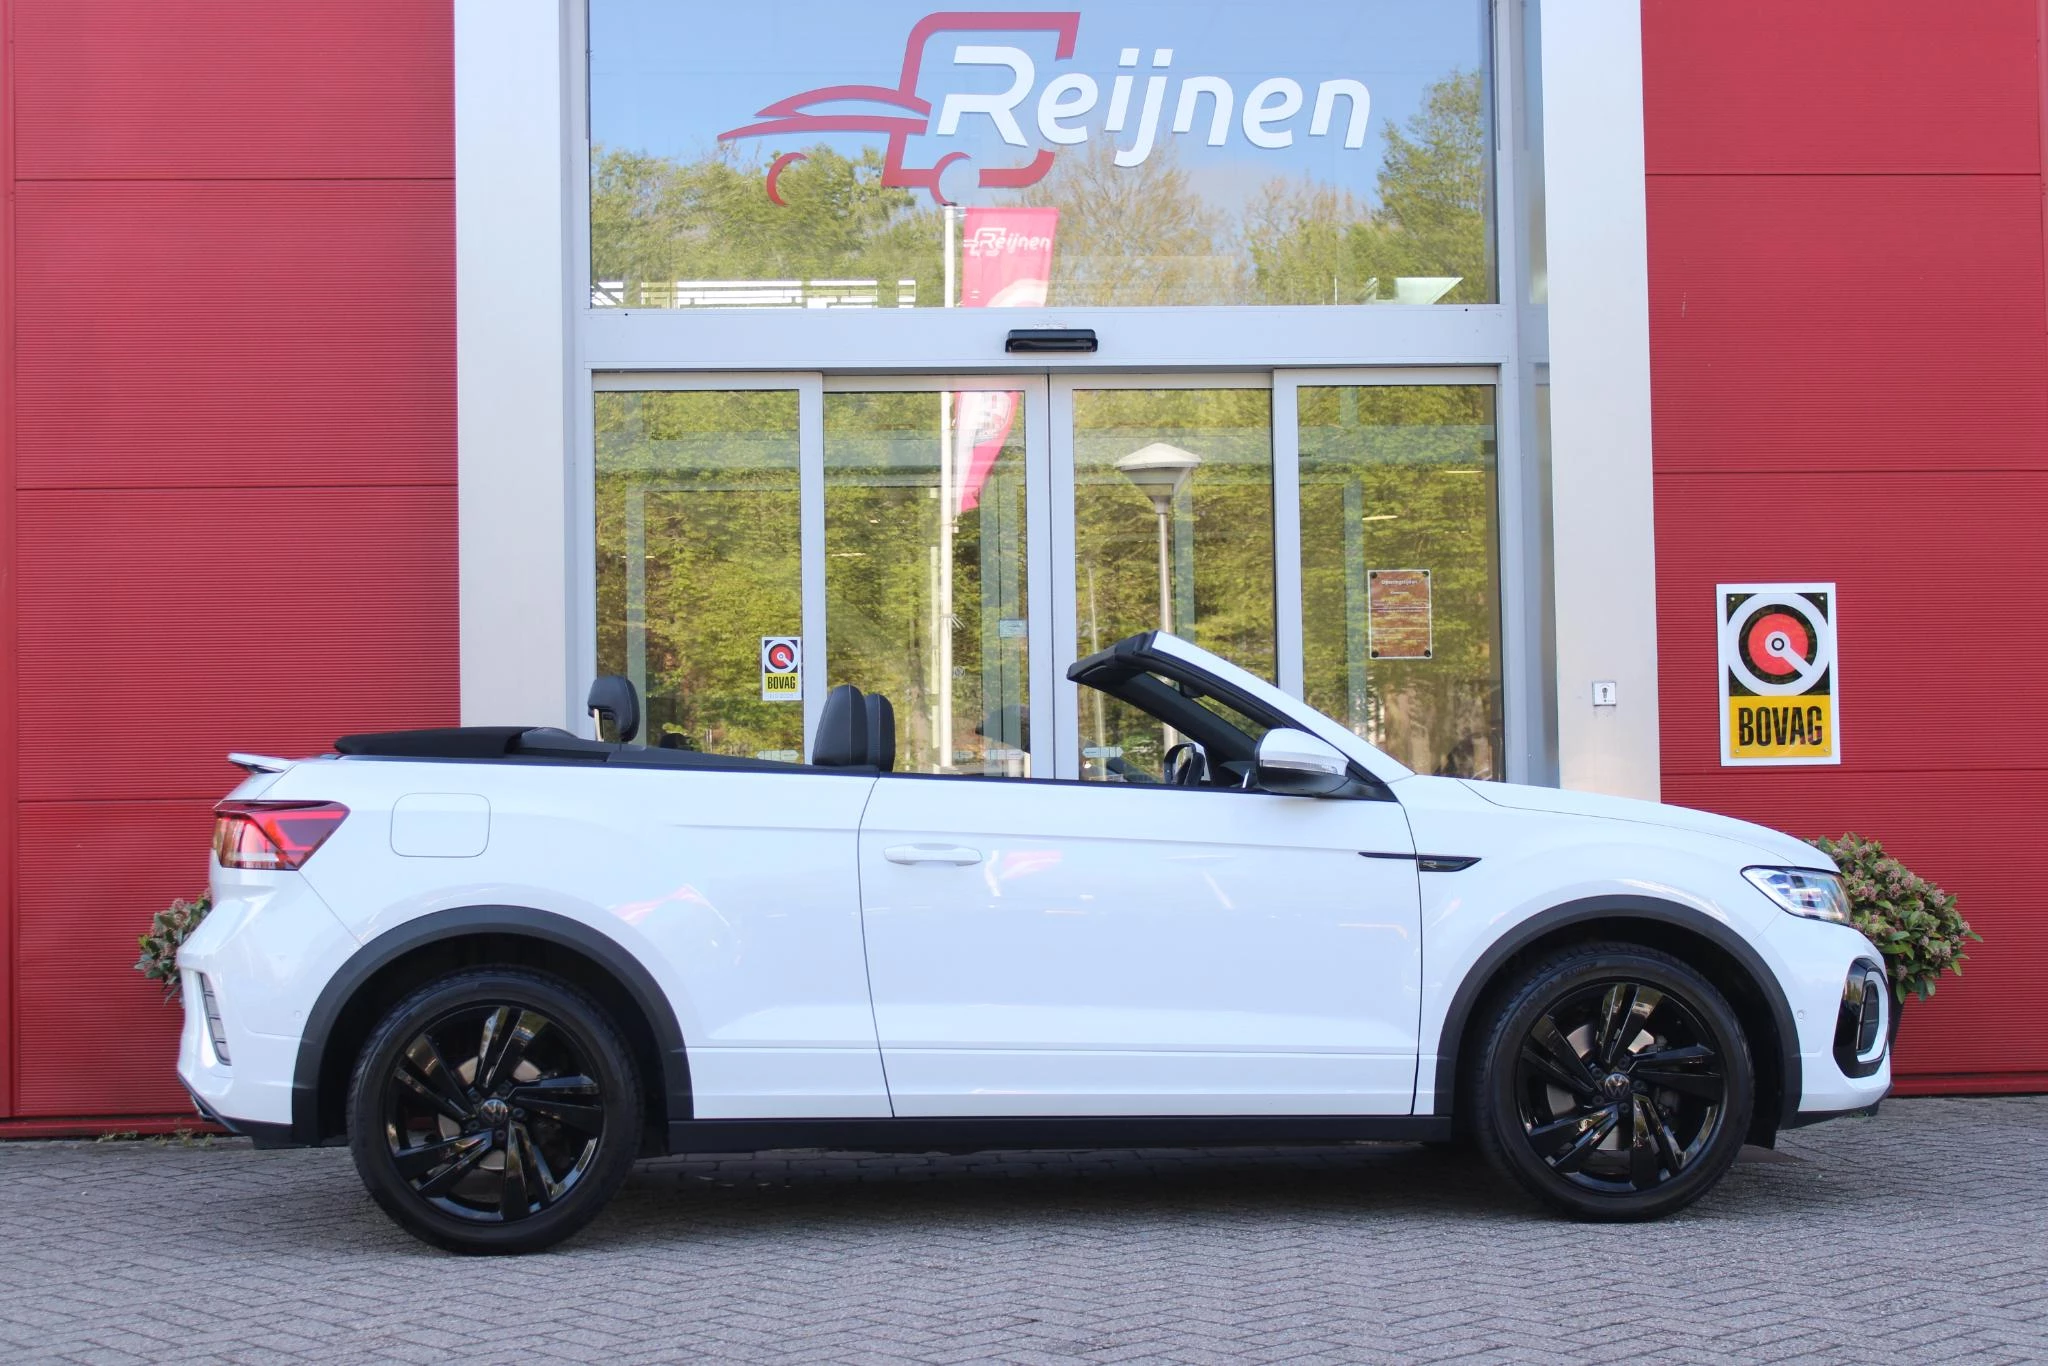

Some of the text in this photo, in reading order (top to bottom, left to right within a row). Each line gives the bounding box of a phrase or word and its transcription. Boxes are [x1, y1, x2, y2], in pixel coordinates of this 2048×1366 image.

[936, 45, 1371, 167] Reijnen
[980, 232, 1051, 254] Reijnen
[767, 676, 796, 690] BOVAG
[1738, 706, 1823, 746] BOVAG
